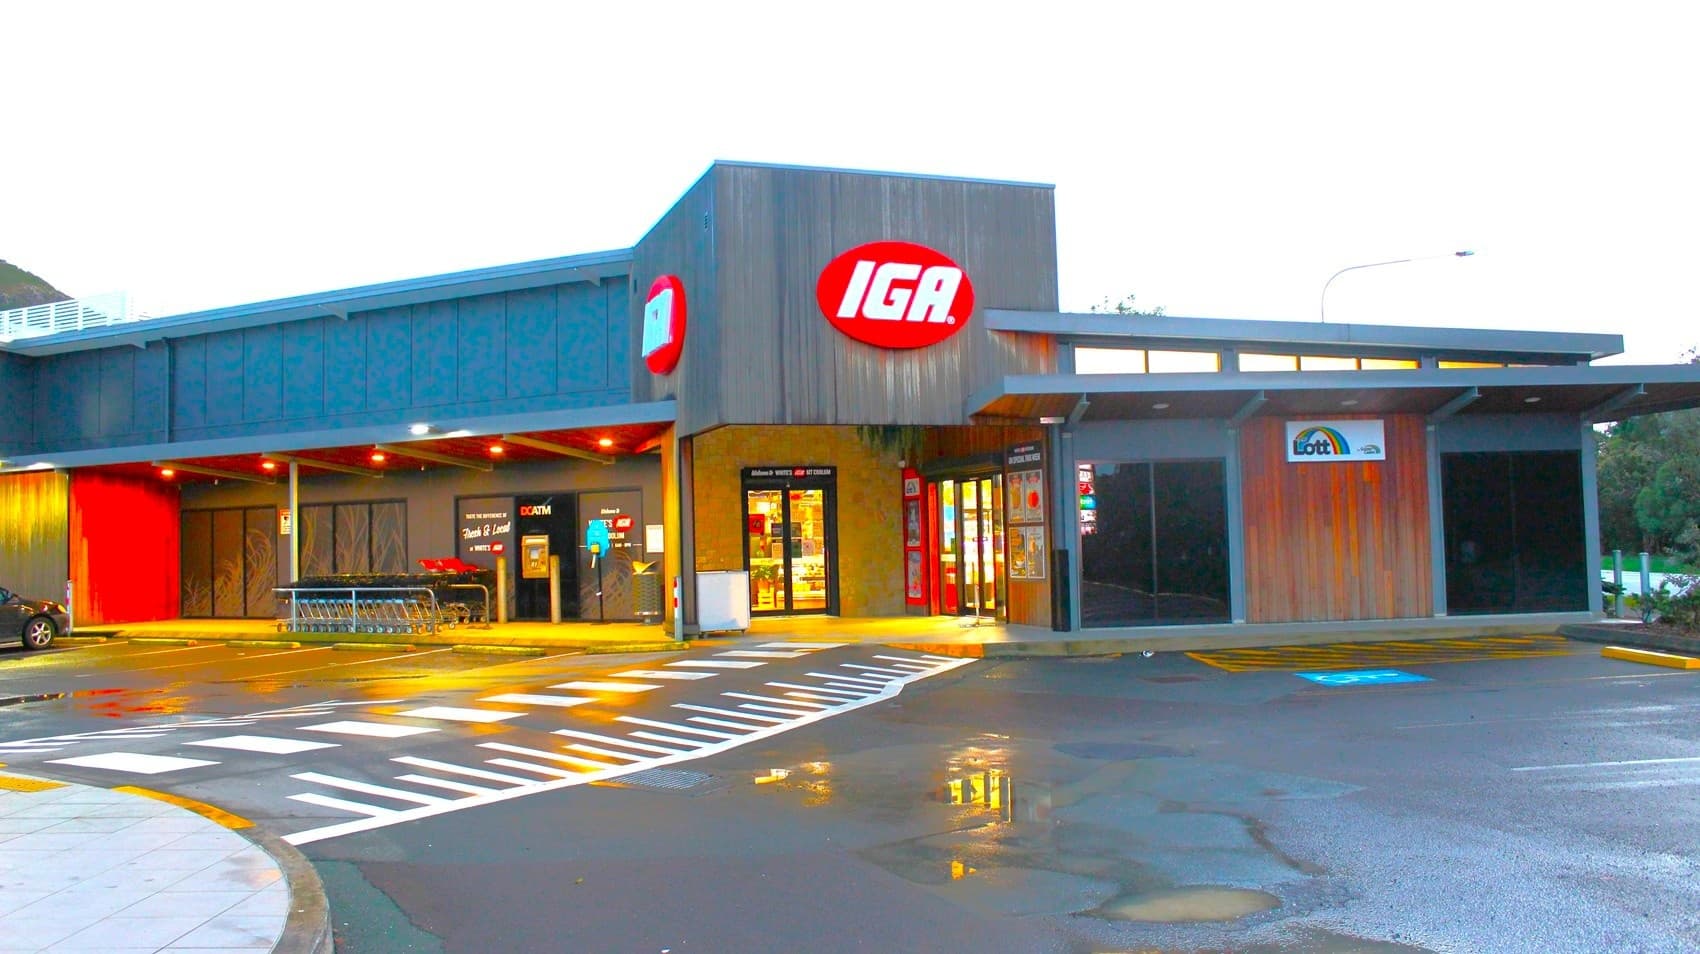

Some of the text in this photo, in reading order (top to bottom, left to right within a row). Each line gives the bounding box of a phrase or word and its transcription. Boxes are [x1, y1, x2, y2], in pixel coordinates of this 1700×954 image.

[836, 260, 963, 323] IGA
[1293, 439, 1331, 455] Lott
[483, 524, 490, 536] &
[492, 521, 511, 535] Local
